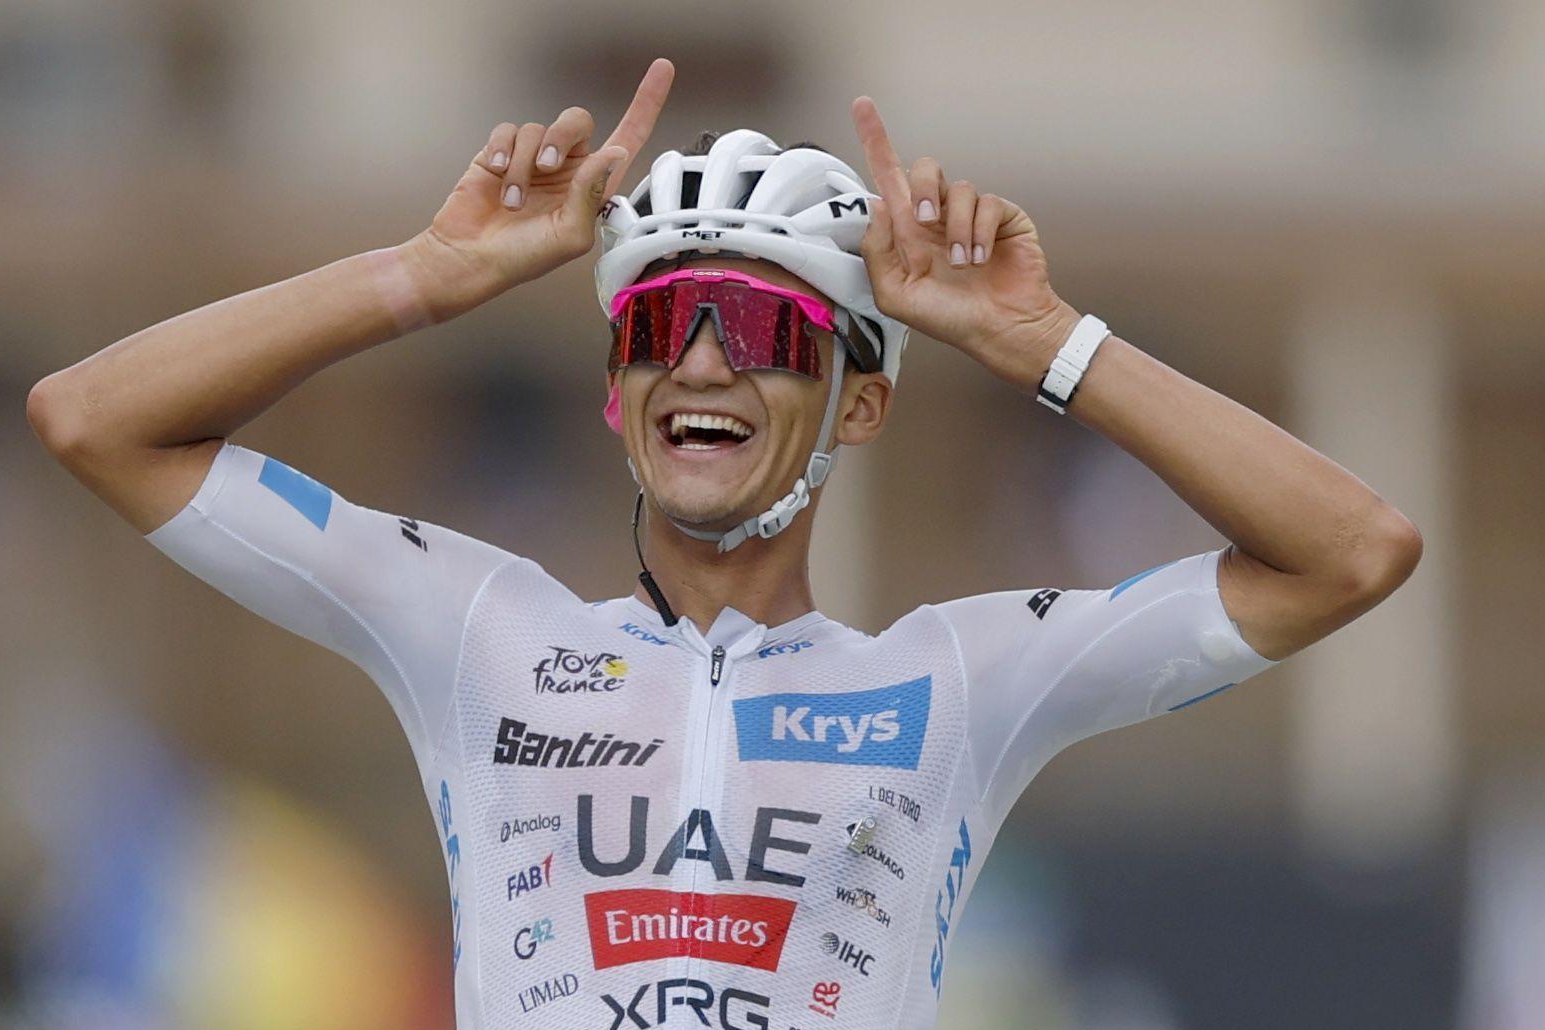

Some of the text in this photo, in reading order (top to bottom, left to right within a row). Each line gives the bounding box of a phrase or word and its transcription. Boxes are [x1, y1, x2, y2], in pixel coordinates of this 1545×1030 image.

[682, 230, 727, 241] MET
[620, 622, 668, 647] Krys
[758, 640, 815, 659] Krys
[493, 717, 666, 768] Santini
[770, 704, 902, 753] Krys
[878, 788, 895, 807] DEL
[899, 794, 922, 822] TORO
[512, 814, 562, 839] Analog
[576, 794, 823, 888] UAE
[514, 917, 556, 960] G42
[603, 908, 769, 949] Emirates
[838, 941, 876, 977] IHC
